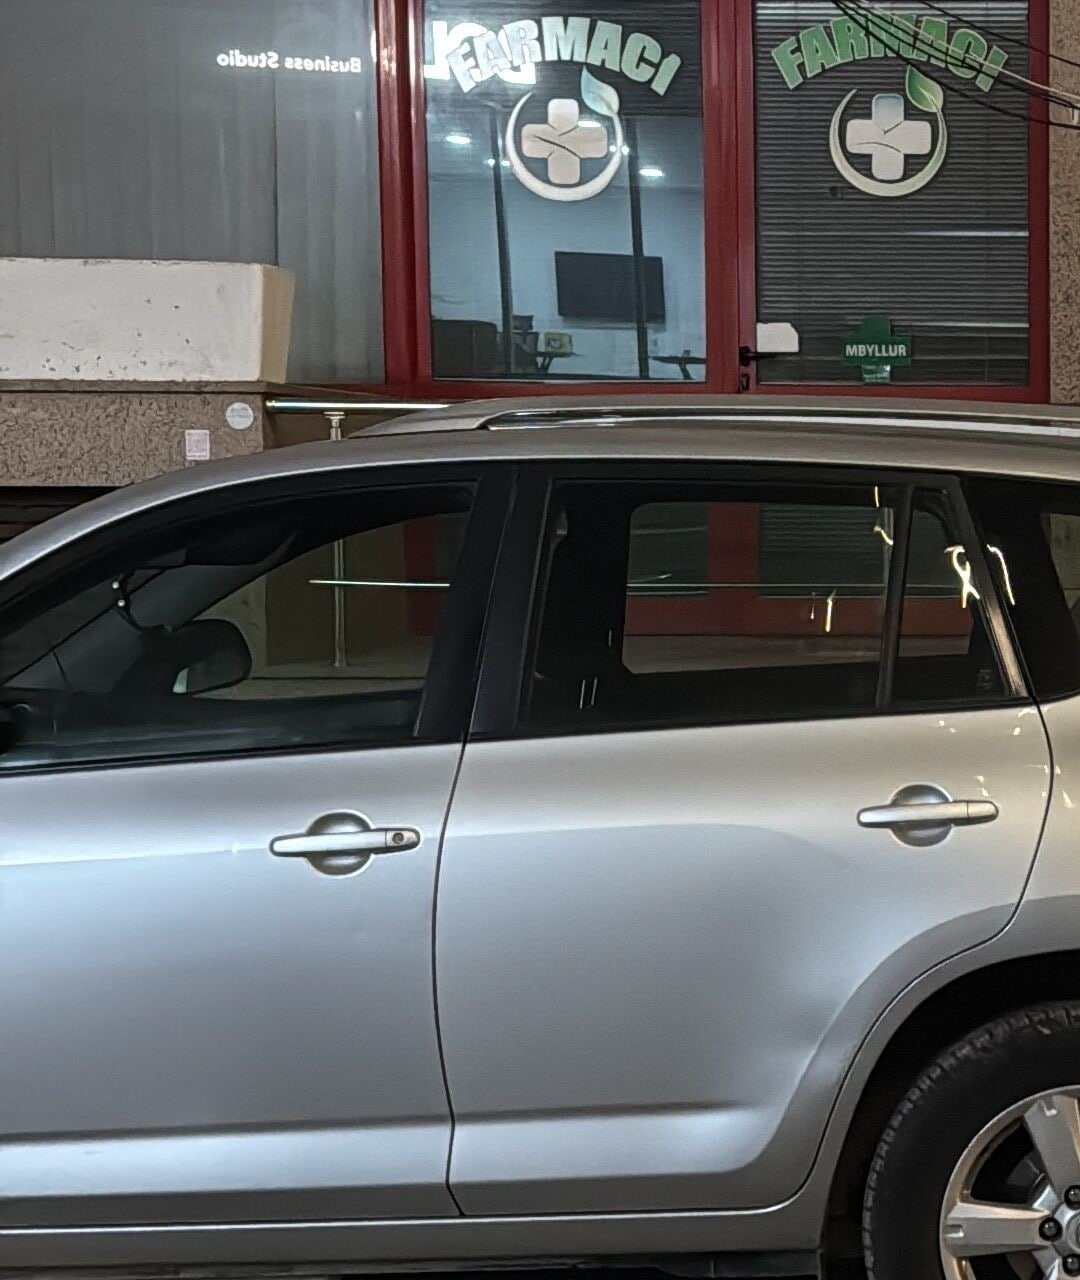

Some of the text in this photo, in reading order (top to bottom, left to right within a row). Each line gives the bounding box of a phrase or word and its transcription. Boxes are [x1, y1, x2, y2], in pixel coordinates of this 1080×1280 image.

[448, 16, 682, 93] FARMACI
[771, 13, 1009, 93] FARMACI
[845, 344, 907, 357] MBYLLUR
